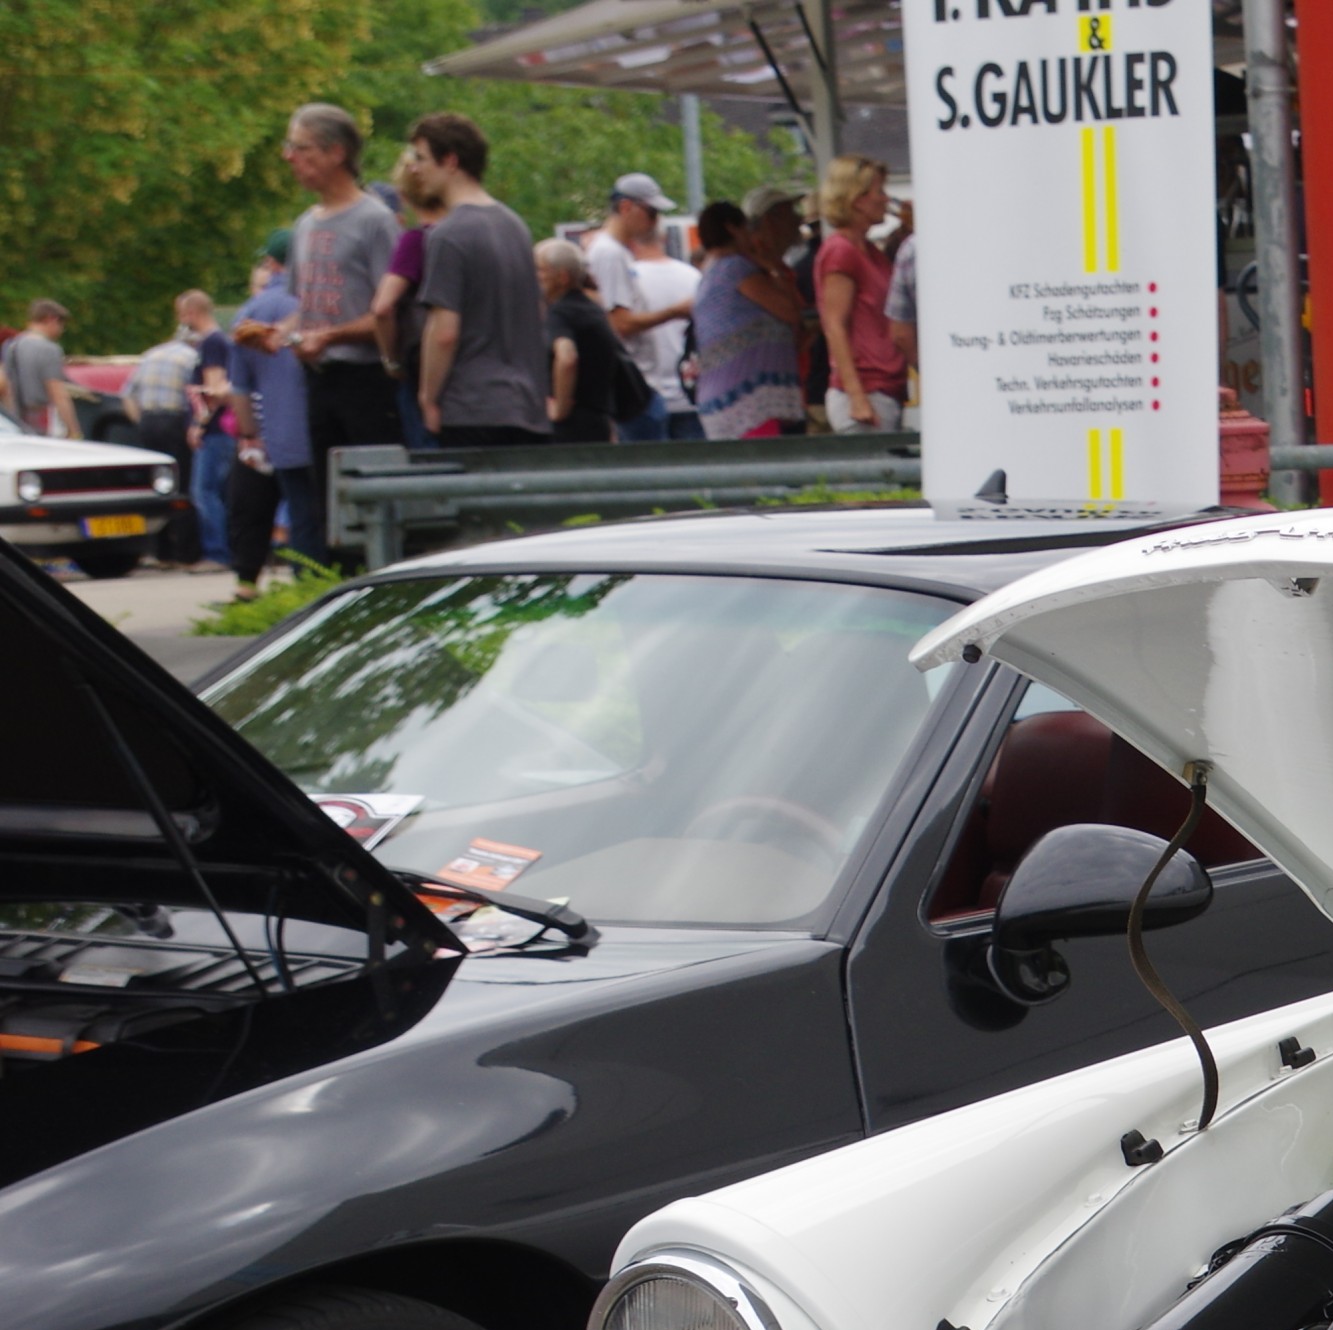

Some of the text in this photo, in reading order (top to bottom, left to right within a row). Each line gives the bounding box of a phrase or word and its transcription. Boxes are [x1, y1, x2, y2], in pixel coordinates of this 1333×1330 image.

[1088, 17, 1105, 50] &
[936, 51, 1179, 131] S.GAUKLER
[1009, 284, 1030, 299] KFZ
